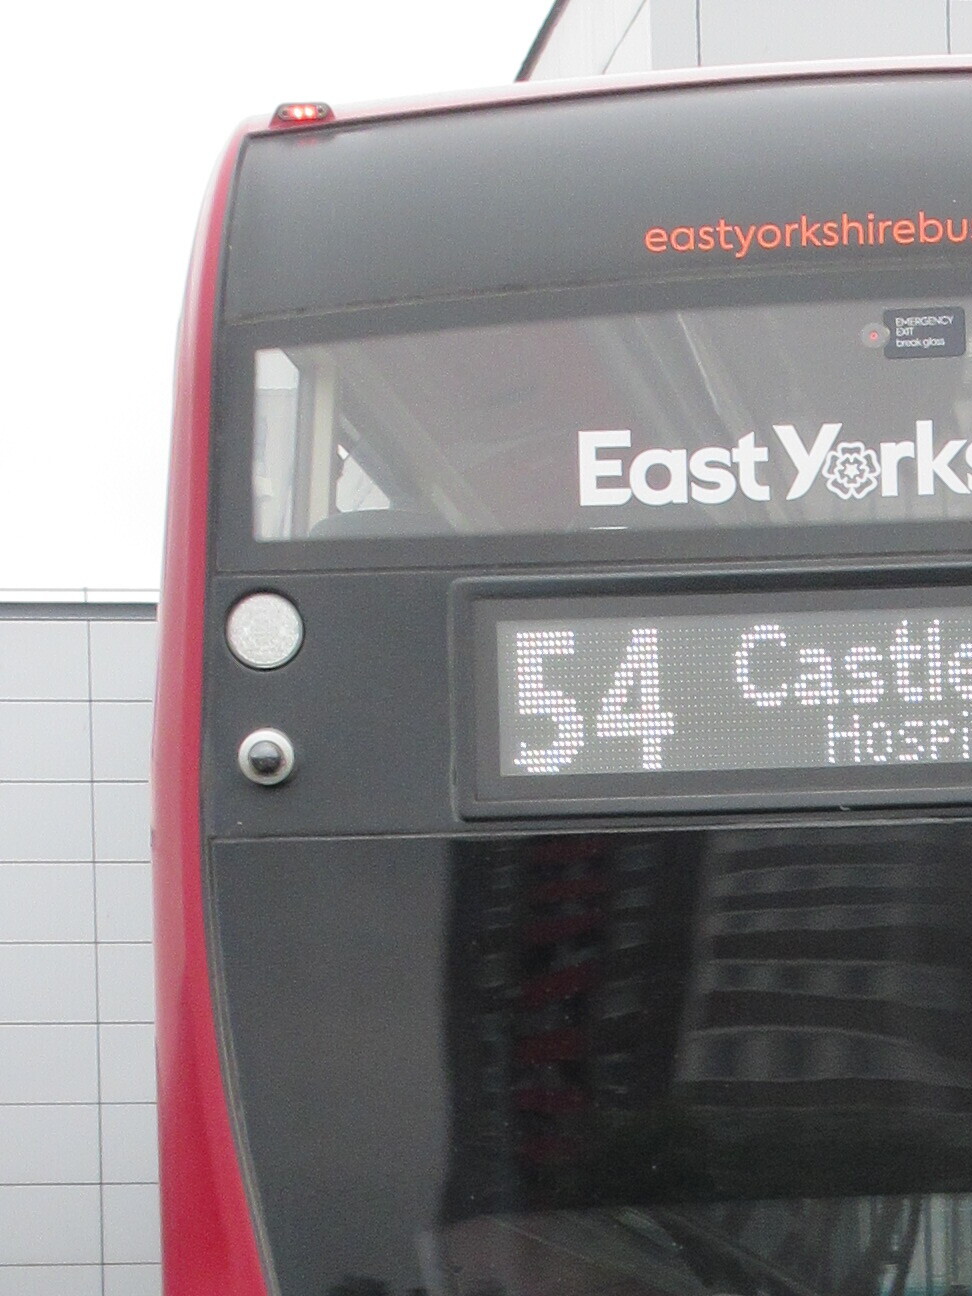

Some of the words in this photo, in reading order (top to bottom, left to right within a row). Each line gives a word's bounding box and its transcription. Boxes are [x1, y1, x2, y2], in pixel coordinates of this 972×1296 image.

[895, 315, 954, 326] EMERGENCY
[896, 327, 914, 337] EXIT
[896, 338, 921, 348] break
[922, 337, 946, 349] glass
[578, 429, 770, 506] East
[514, 628, 675, 773] 54
